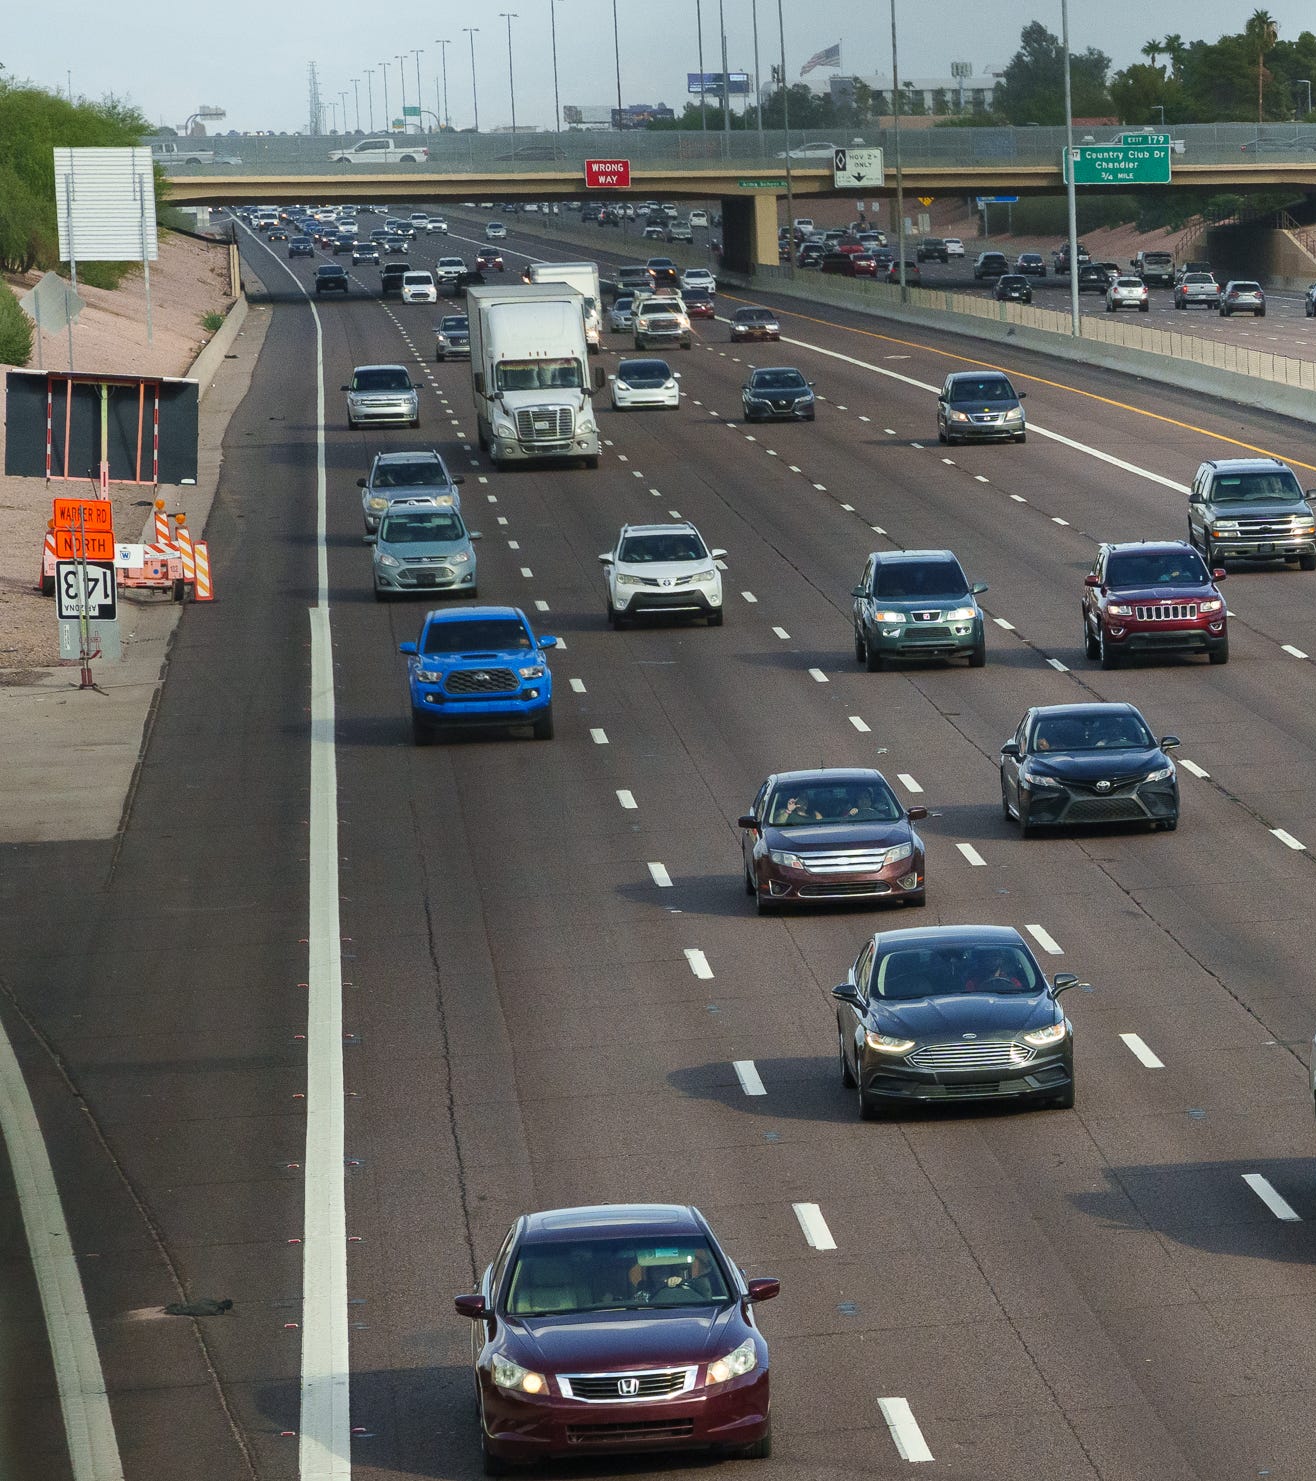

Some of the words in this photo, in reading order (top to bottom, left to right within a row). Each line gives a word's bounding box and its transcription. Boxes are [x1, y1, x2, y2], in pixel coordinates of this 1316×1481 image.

[1148, 136, 1164, 144] 179
[1085, 151, 1124, 160] Country
[1128, 150, 1150, 159] Club
[591, 163, 624, 172] WRONG
[1095, 161, 1139, 169] Chandler
[598, 175, 618, 184] WAY
[96, 508, 107, 524] RD
[64, 537, 106, 553] NORTH
[64, 604, 96, 612] ARZONA
